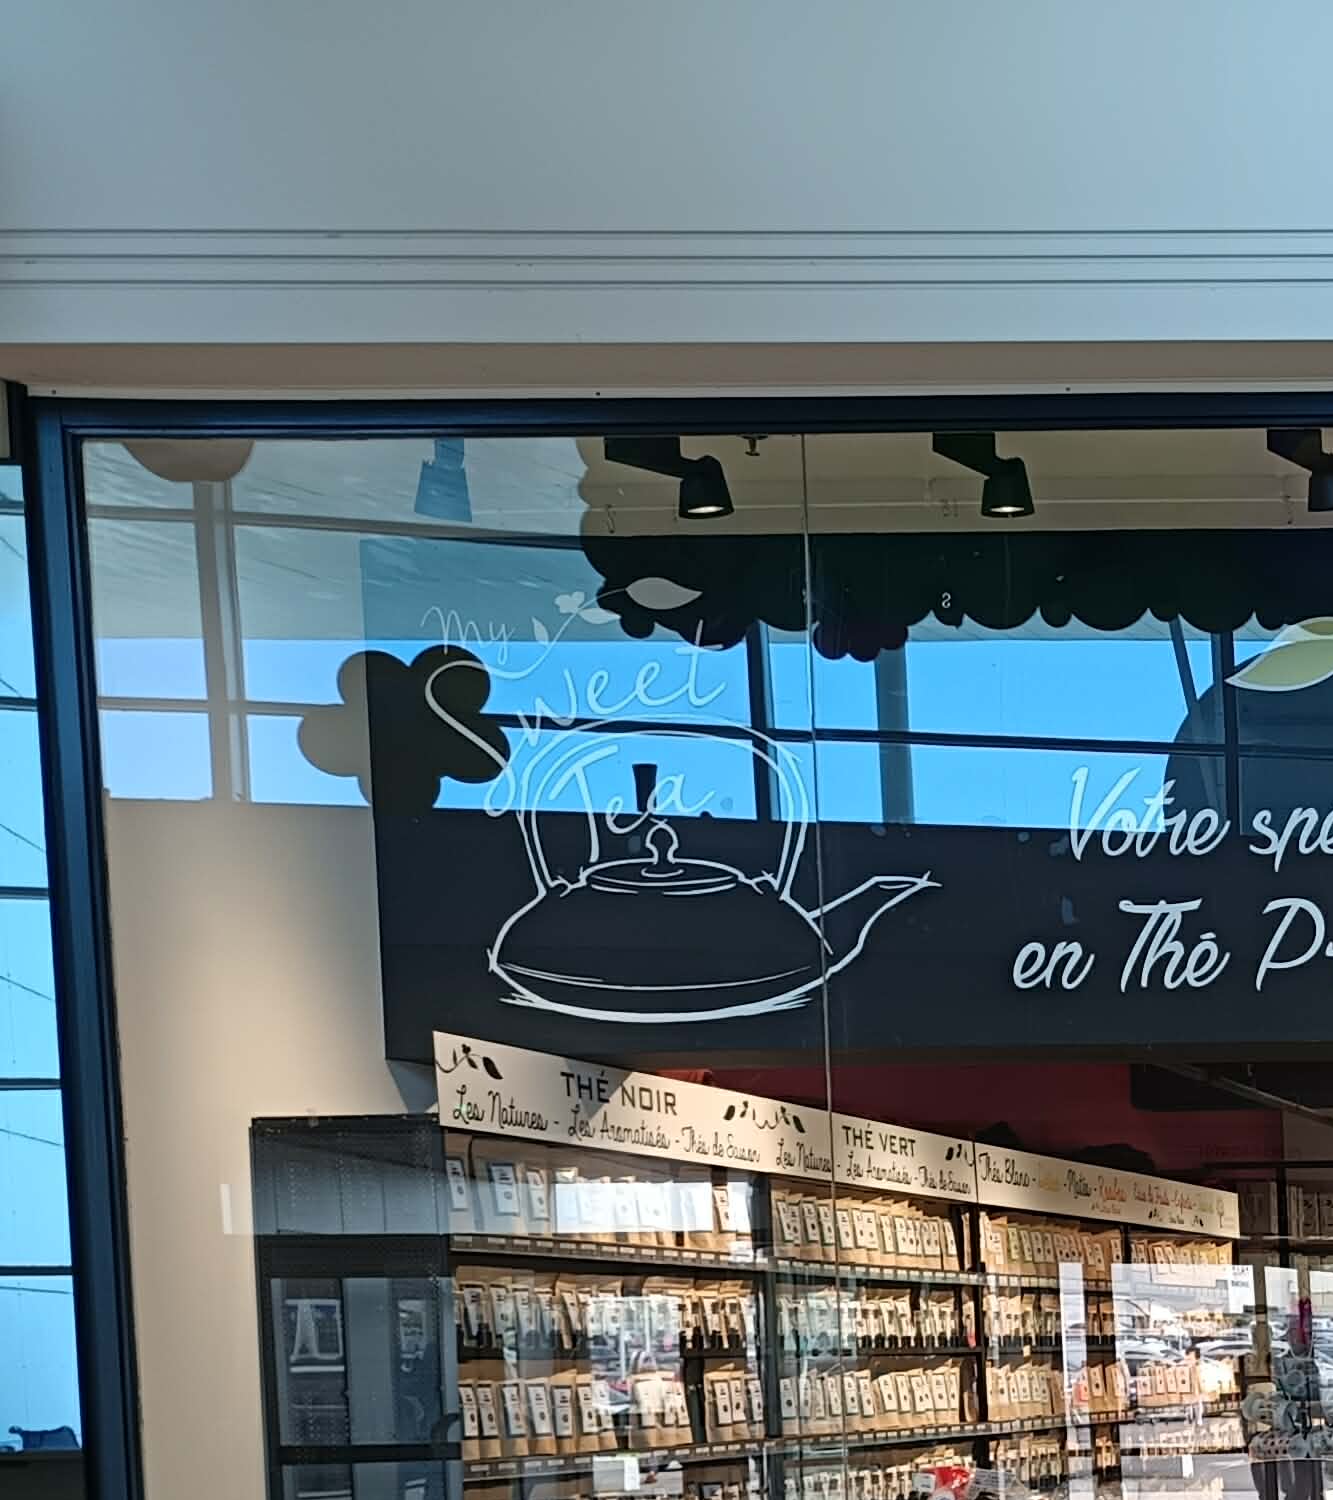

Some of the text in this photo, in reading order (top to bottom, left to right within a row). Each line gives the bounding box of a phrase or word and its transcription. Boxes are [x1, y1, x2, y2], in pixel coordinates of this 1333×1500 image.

[424, 619, 727, 817] Sweet
[549, 745, 716, 863] Tea
[1068, 766, 1231, 863] Votre
[1012, 939, 1095, 991] en
[1118, 897, 1231, 994] Thé
[452, 1084, 485, 1124] Les
[488, 1090, 549, 1132] Natures
[560, 1069, 678, 1116] THÉ NOIR
[841, 1122, 916, 1159] THÉ VERT
